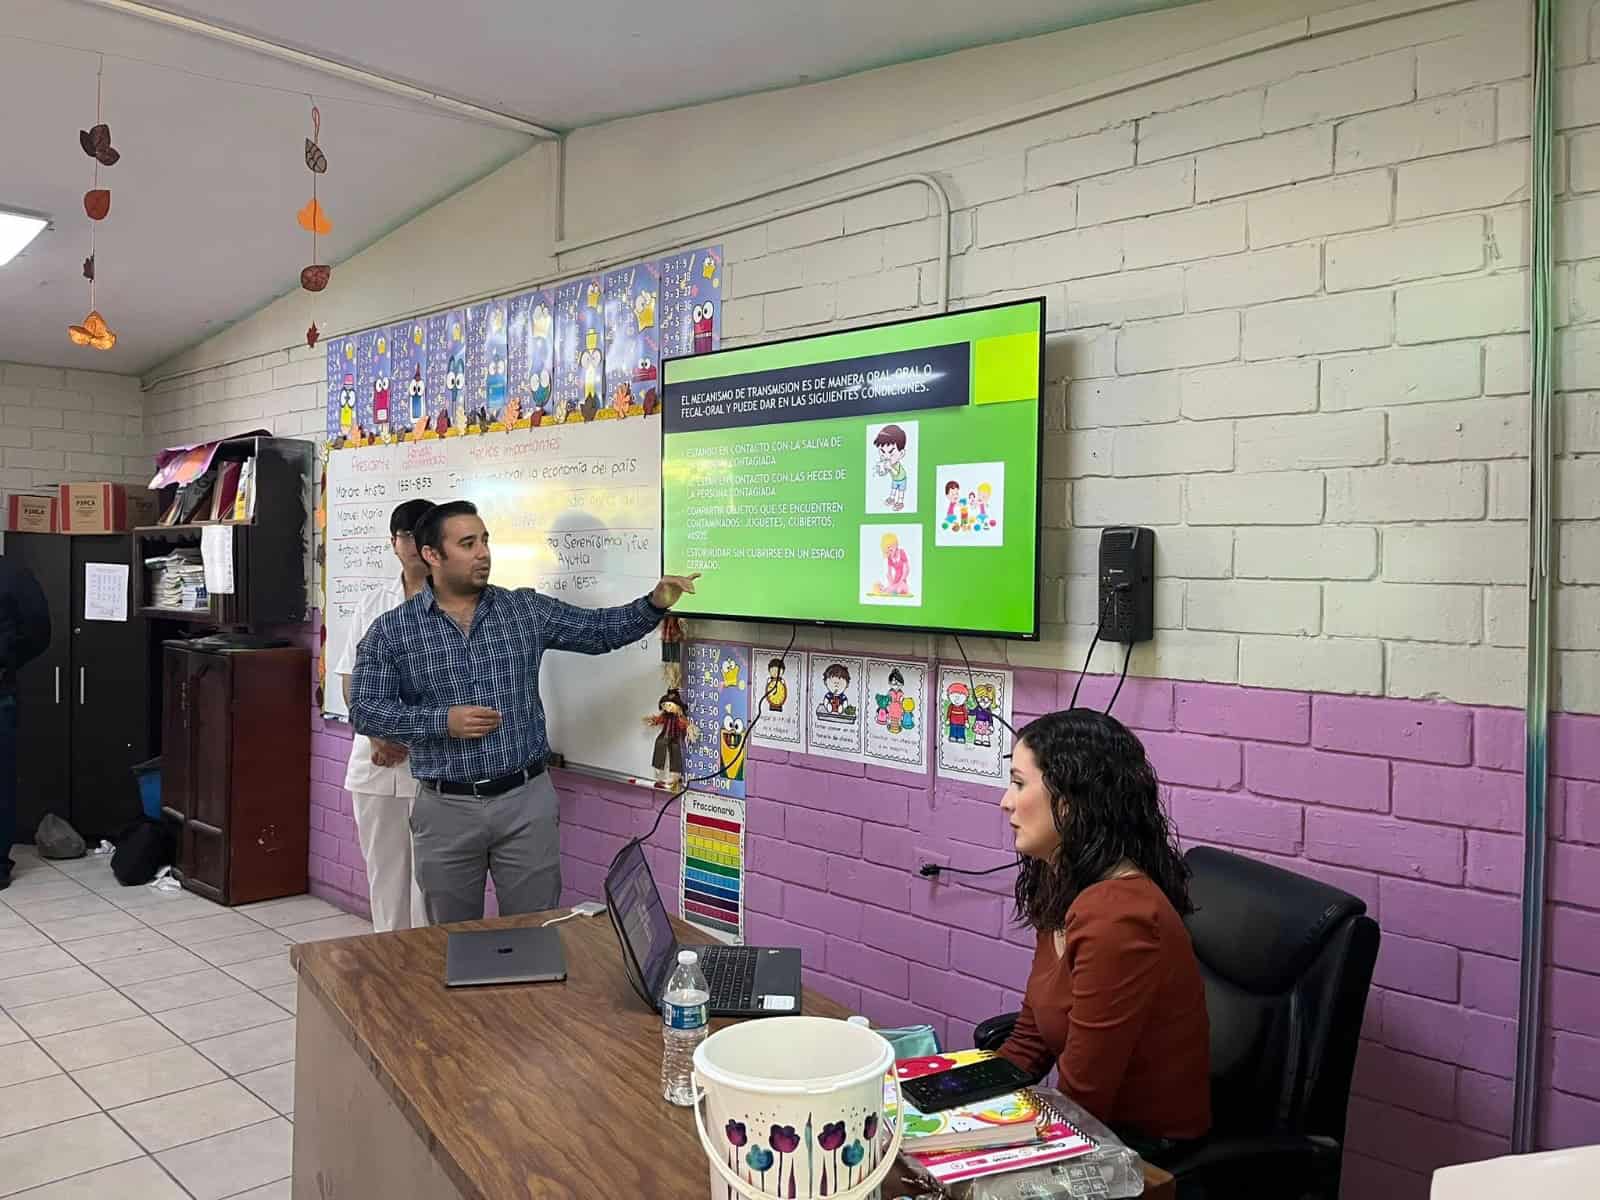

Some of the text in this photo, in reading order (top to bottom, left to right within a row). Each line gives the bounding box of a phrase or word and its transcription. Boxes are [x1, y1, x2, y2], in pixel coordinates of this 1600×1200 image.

[681, 395, 690, 406] EL
[691, 389, 734, 405] MECANISMO
[735, 387, 745, 399] DE
[747, 381, 800, 397] TRANSMISION
[802, 379, 812, 391] ES
[814, 377, 826, 390] DE
[828, 373, 865, 388] MANERA
[681, 380, 931, 418] FECAL-ORAL Y PUEDE DAR EN LAS SIGUIENTES CONDICIONES.
[772, 440, 788, 452] CON
[789, 438, 801, 450] LA
[801, 437, 829, 449] SALIVA
[830, 436, 843, 448] DE
[772, 471, 789, 483] CON
[790, 471, 805, 482] LAS
[807, 469, 833, 481] HECES
[835, 468, 847, 480] DE
[760, 503, 776, 514] QUE
[777, 503, 787, 513] SE
[789, 501, 844, 513] ENCUENTREN
[558, 553, 591, 570] Ayutla
[784, 549, 795, 559] EN
[797, 549, 810, 560] UN
[811, 548, 845, 560] ESPACIO
[693, 799, 735, 817] Fraccionario
